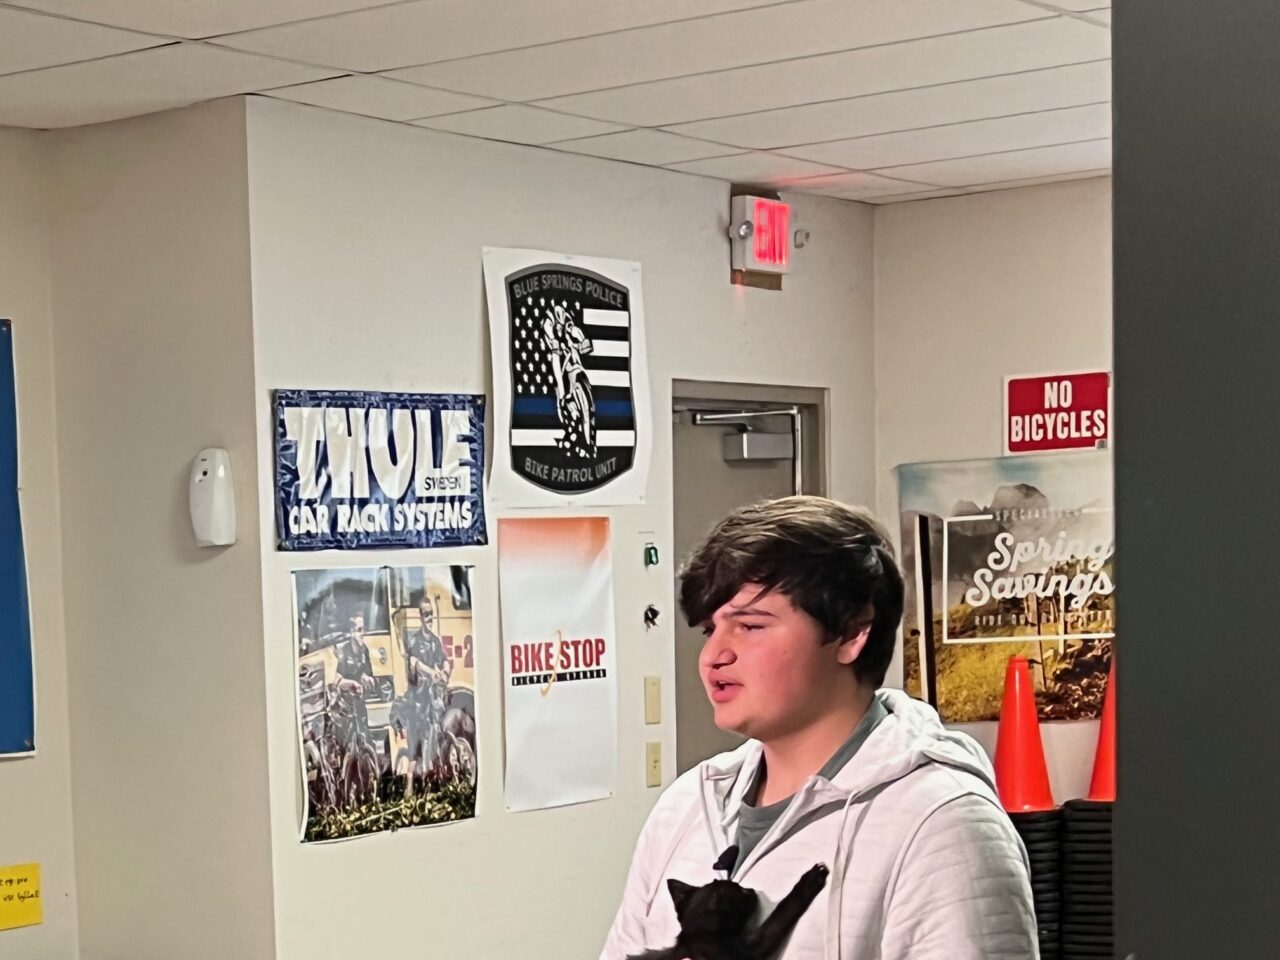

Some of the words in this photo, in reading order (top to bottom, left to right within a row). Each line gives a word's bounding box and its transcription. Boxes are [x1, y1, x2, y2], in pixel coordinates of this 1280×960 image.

[513, 276, 539, 298] BLUE
[541, 274, 582, 292] SPRINGS
[585, 280, 623, 307] POLICE
[1044, 380, 1072, 409] NO
[1010, 409, 1105, 442] BICYCLES
[284, 406, 470, 499] THULE
[524, 457, 549, 479] BIKE
[551, 467, 594, 482] PATROL
[595, 457, 616, 478] UNIT
[289, 504, 330, 534] CAR
[337, 503, 390, 532] RACK
[393, 502, 471, 531] SYSTEMS
[987, 531, 1115, 572] Spring
[965, 567, 1115, 608] Savings
[510, 642, 554, 674] BIKE
[560, 638, 606, 670] STOP
